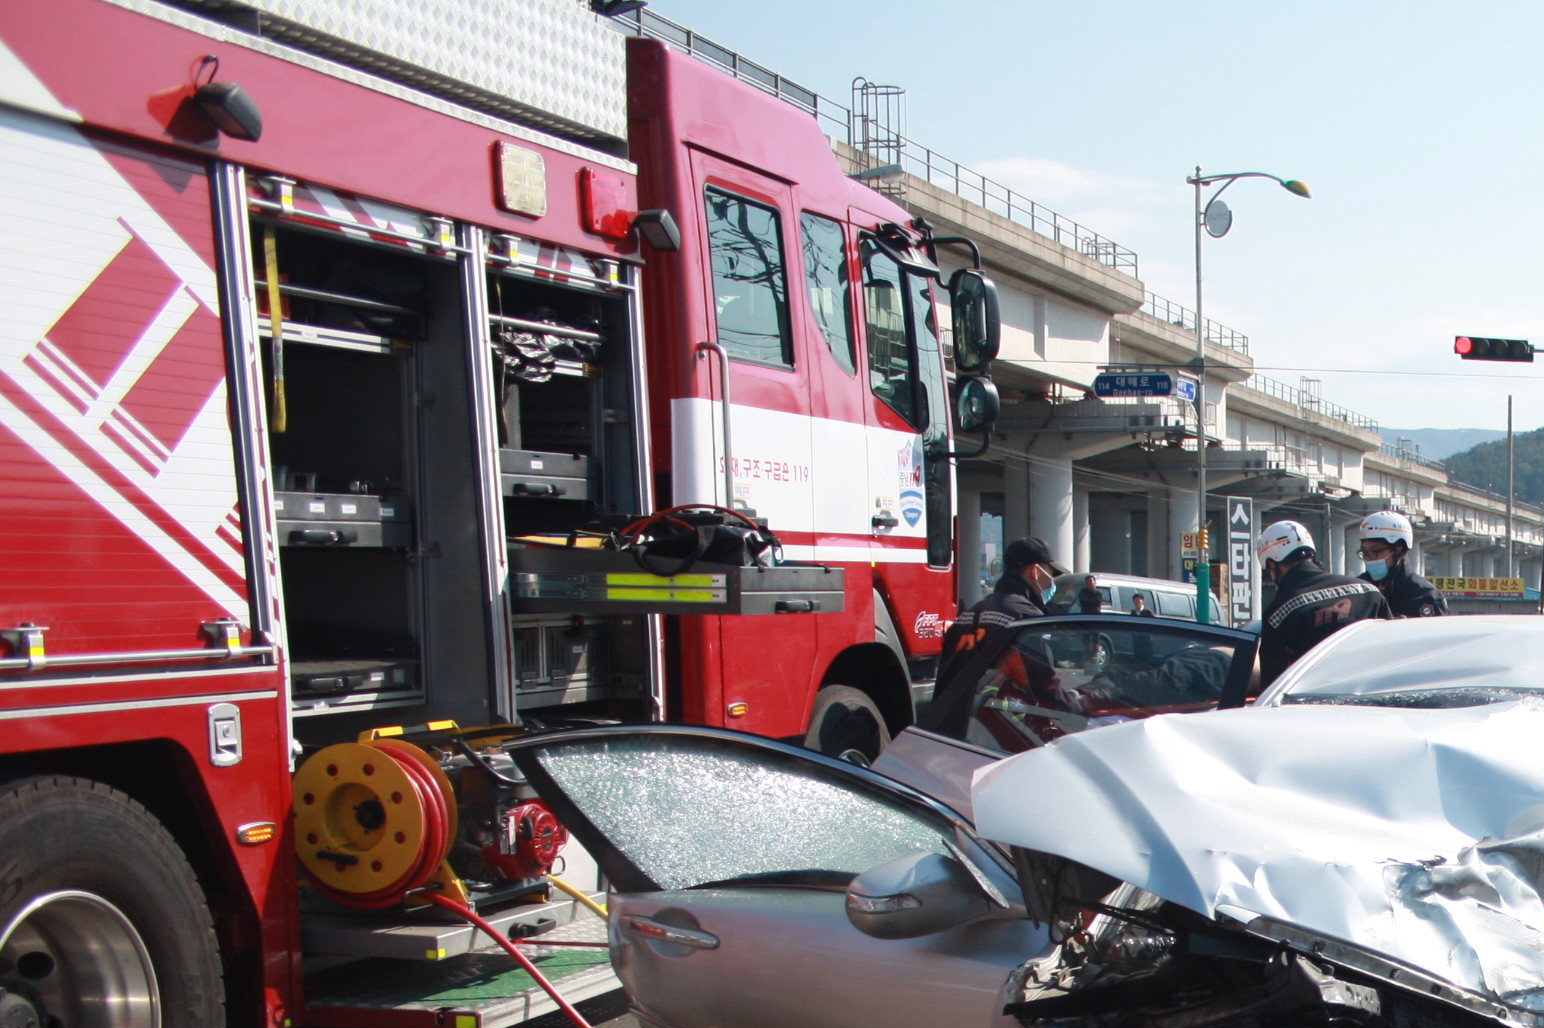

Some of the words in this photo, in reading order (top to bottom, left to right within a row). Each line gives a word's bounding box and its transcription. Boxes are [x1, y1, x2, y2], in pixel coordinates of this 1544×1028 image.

[1115, 376, 1150, 387] 대해로
[793, 465, 809, 483] 119
[1231, 503, 1251, 629] 스타판
